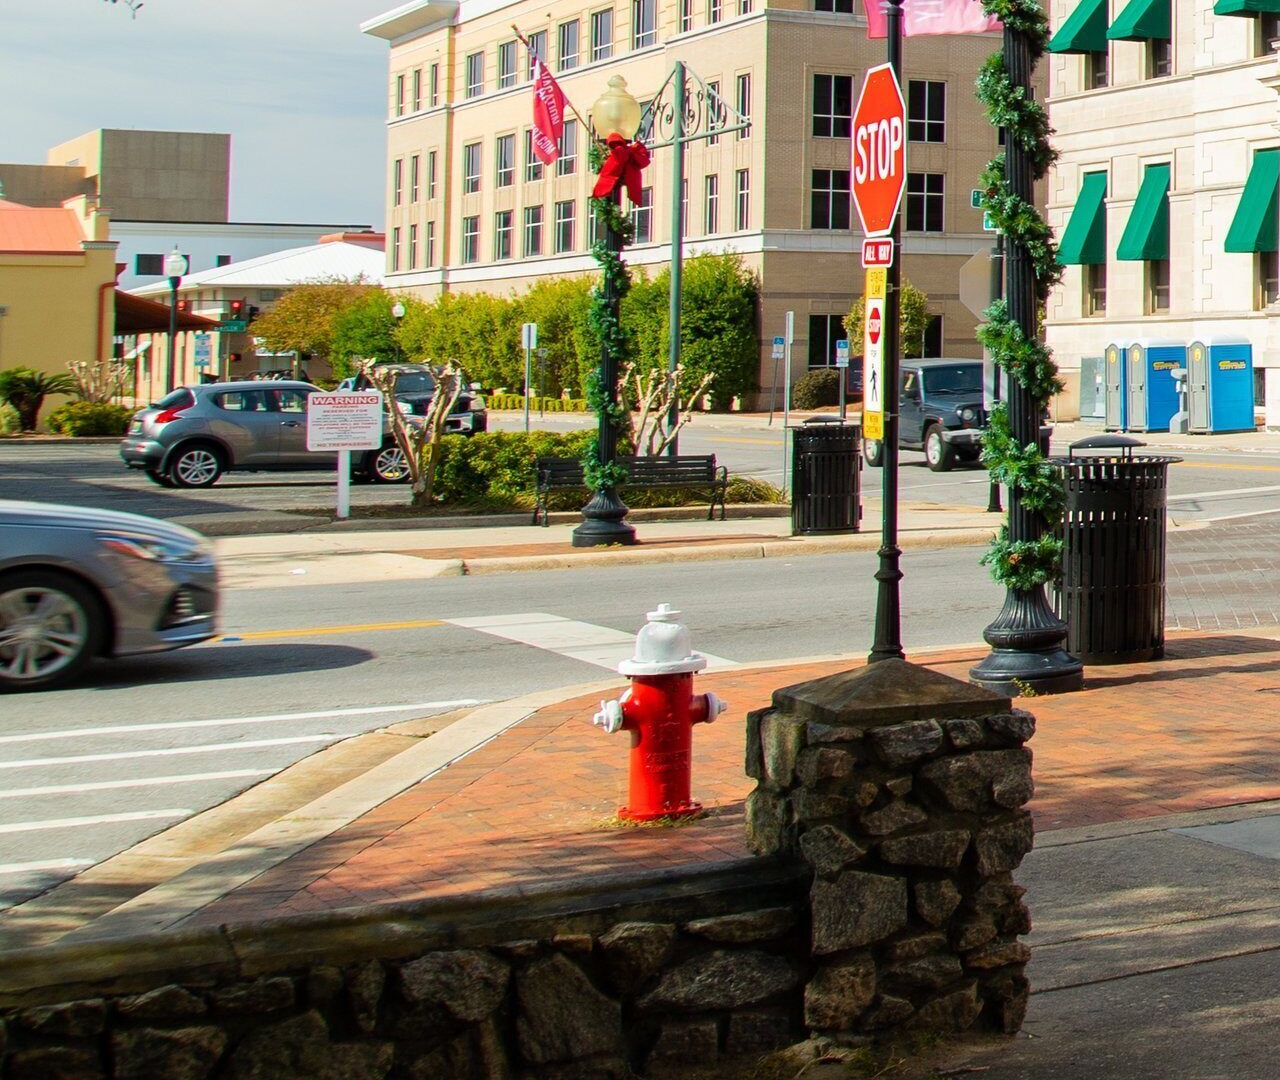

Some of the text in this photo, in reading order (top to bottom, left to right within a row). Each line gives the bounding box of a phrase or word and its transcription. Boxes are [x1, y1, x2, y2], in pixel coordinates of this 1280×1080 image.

[541, 71, 560, 125] VACATION
[855, 116, 902, 185] STOP
[865, 244, 891, 261] ALL WAY
[313, 396, 377, 404] WARNING
